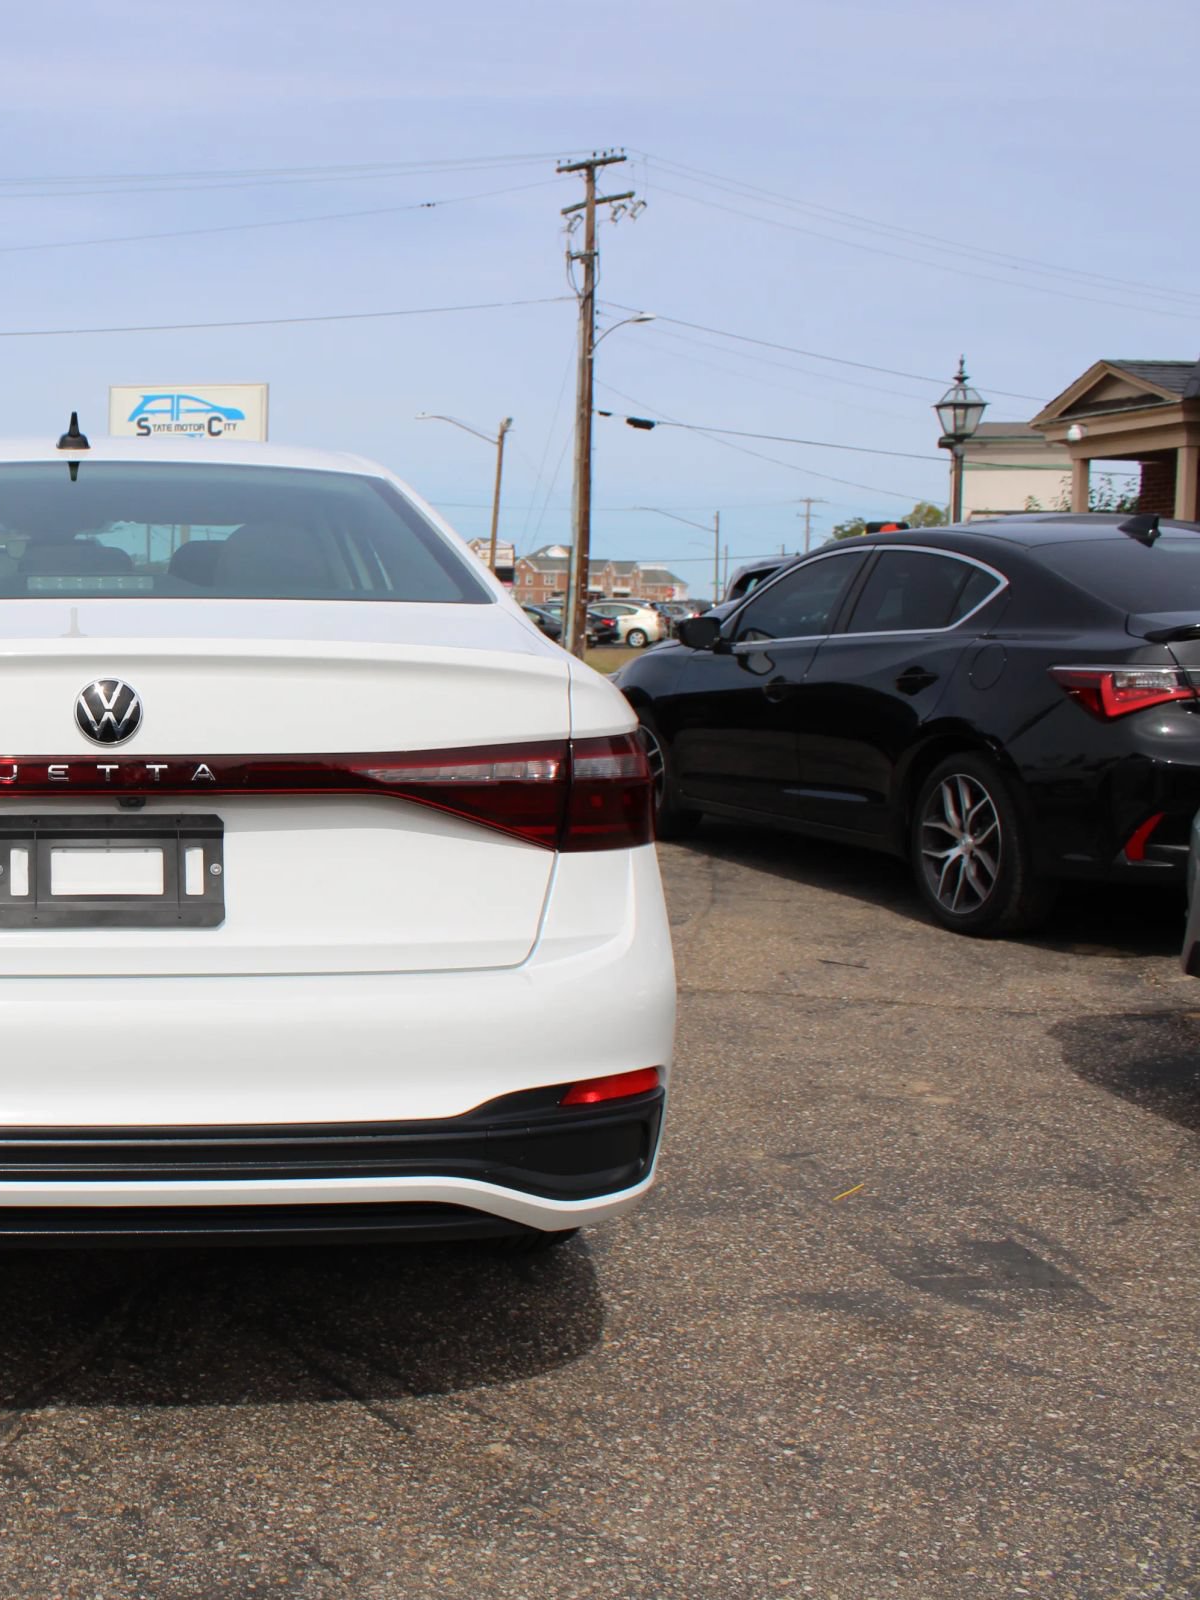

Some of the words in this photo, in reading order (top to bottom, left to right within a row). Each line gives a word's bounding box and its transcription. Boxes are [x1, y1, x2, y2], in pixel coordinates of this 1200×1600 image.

[136, 417, 173, 436] STATE
[174, 423, 205, 432] MOTOR
[208, 416, 238, 437] CITY
[0, 763, 216, 782] JETTA
